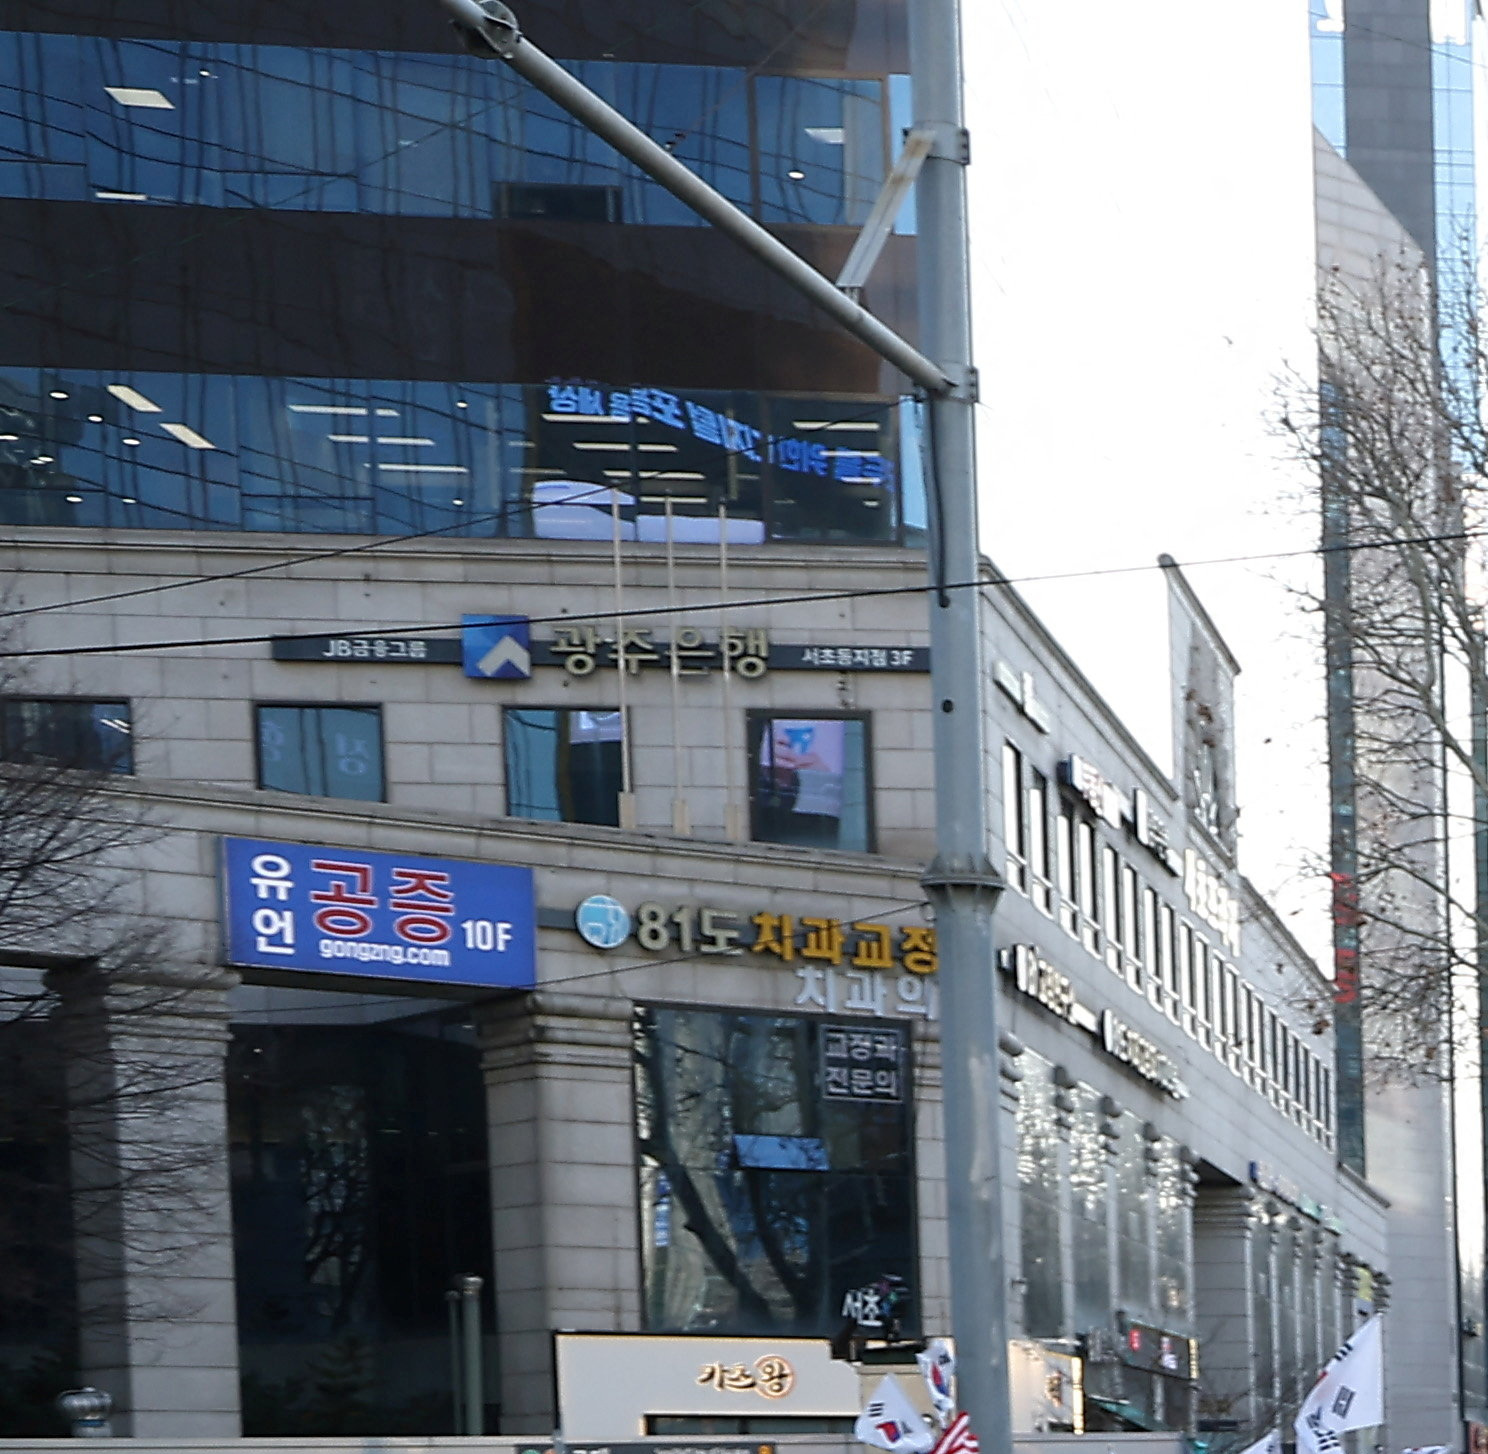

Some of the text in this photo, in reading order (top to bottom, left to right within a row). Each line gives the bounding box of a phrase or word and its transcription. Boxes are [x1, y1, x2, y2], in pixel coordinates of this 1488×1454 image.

[550, 625, 769, 679] 광주은행
[890, 650, 914, 665] 3F
[250, 854, 295, 955] 유언
[309, 859, 514, 951] 공증 10F
[318, 938, 450, 966] gongzng.com
[824, 1066, 898, 1098] 전문의
